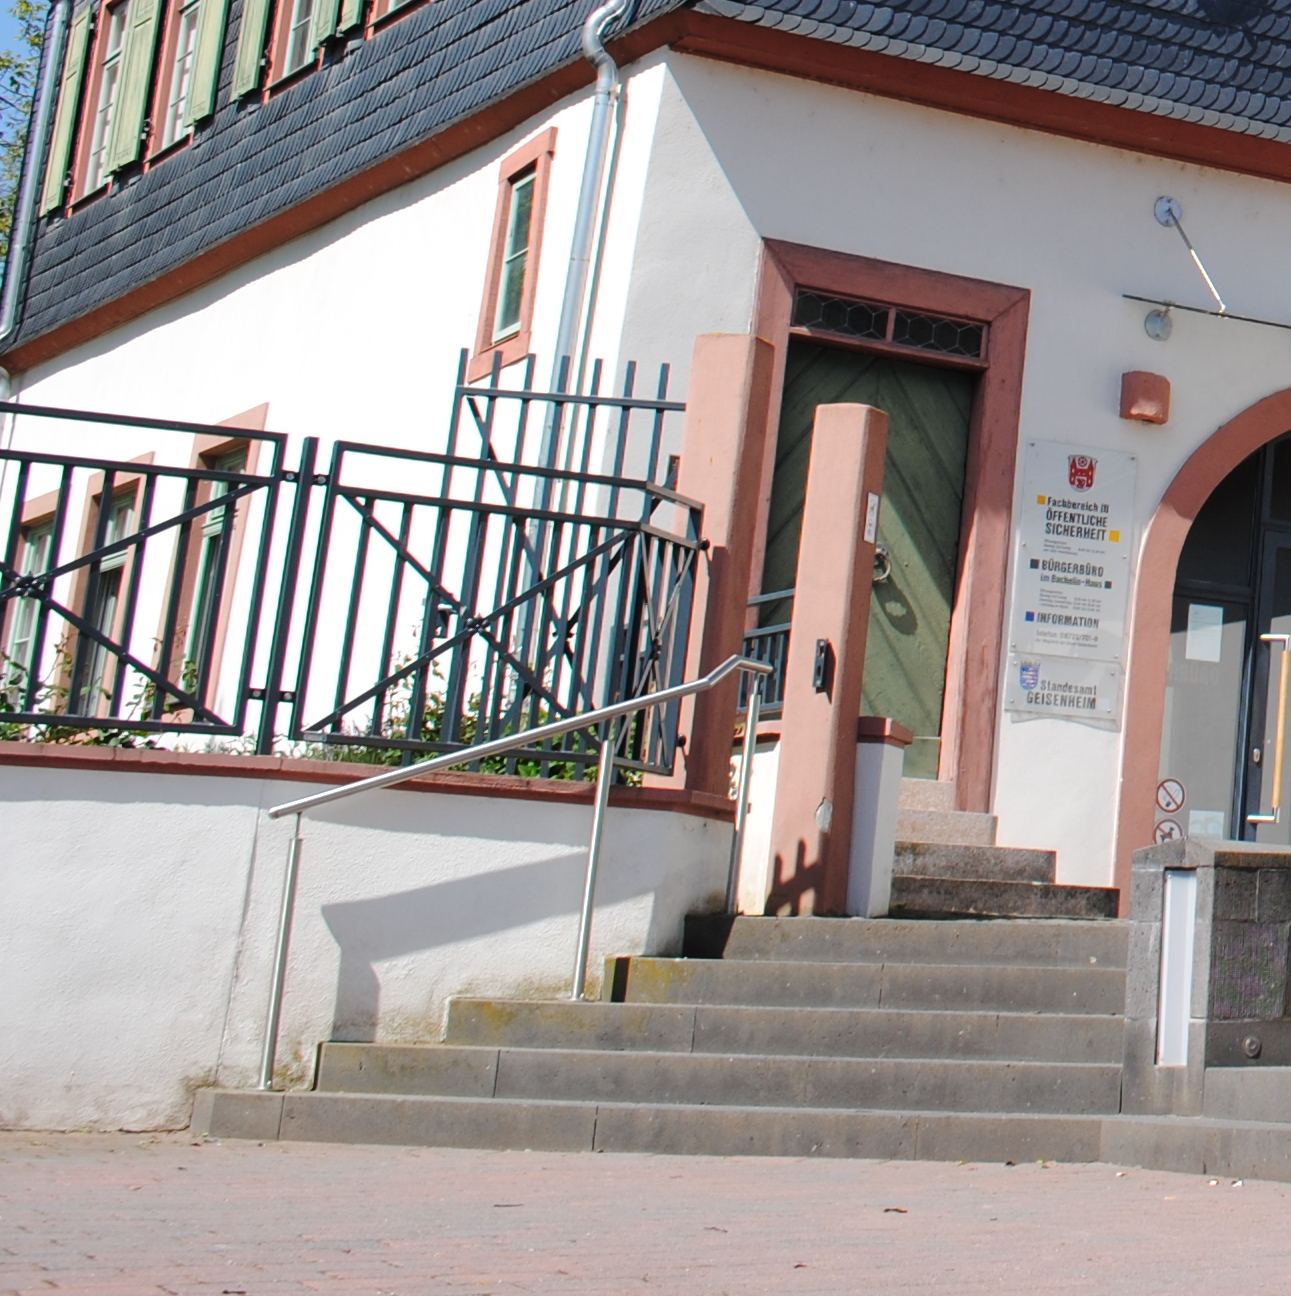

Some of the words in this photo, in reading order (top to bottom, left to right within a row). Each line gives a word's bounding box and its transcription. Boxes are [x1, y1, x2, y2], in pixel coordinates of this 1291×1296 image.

[1048, 496, 1098, 513] Fachbereich
[1046, 507, 1108, 528] ÖFFENTLICHE
[1045, 522, 1107, 542] SICHERHEIT
[1042, 558, 1104, 578] BÜRGERBÜRO
[1037, 612, 1100, 629] INFORMATION
[1040, 679, 1097, 696] Standesamt
[1026, 691, 1097, 710] GEISENHEIM
